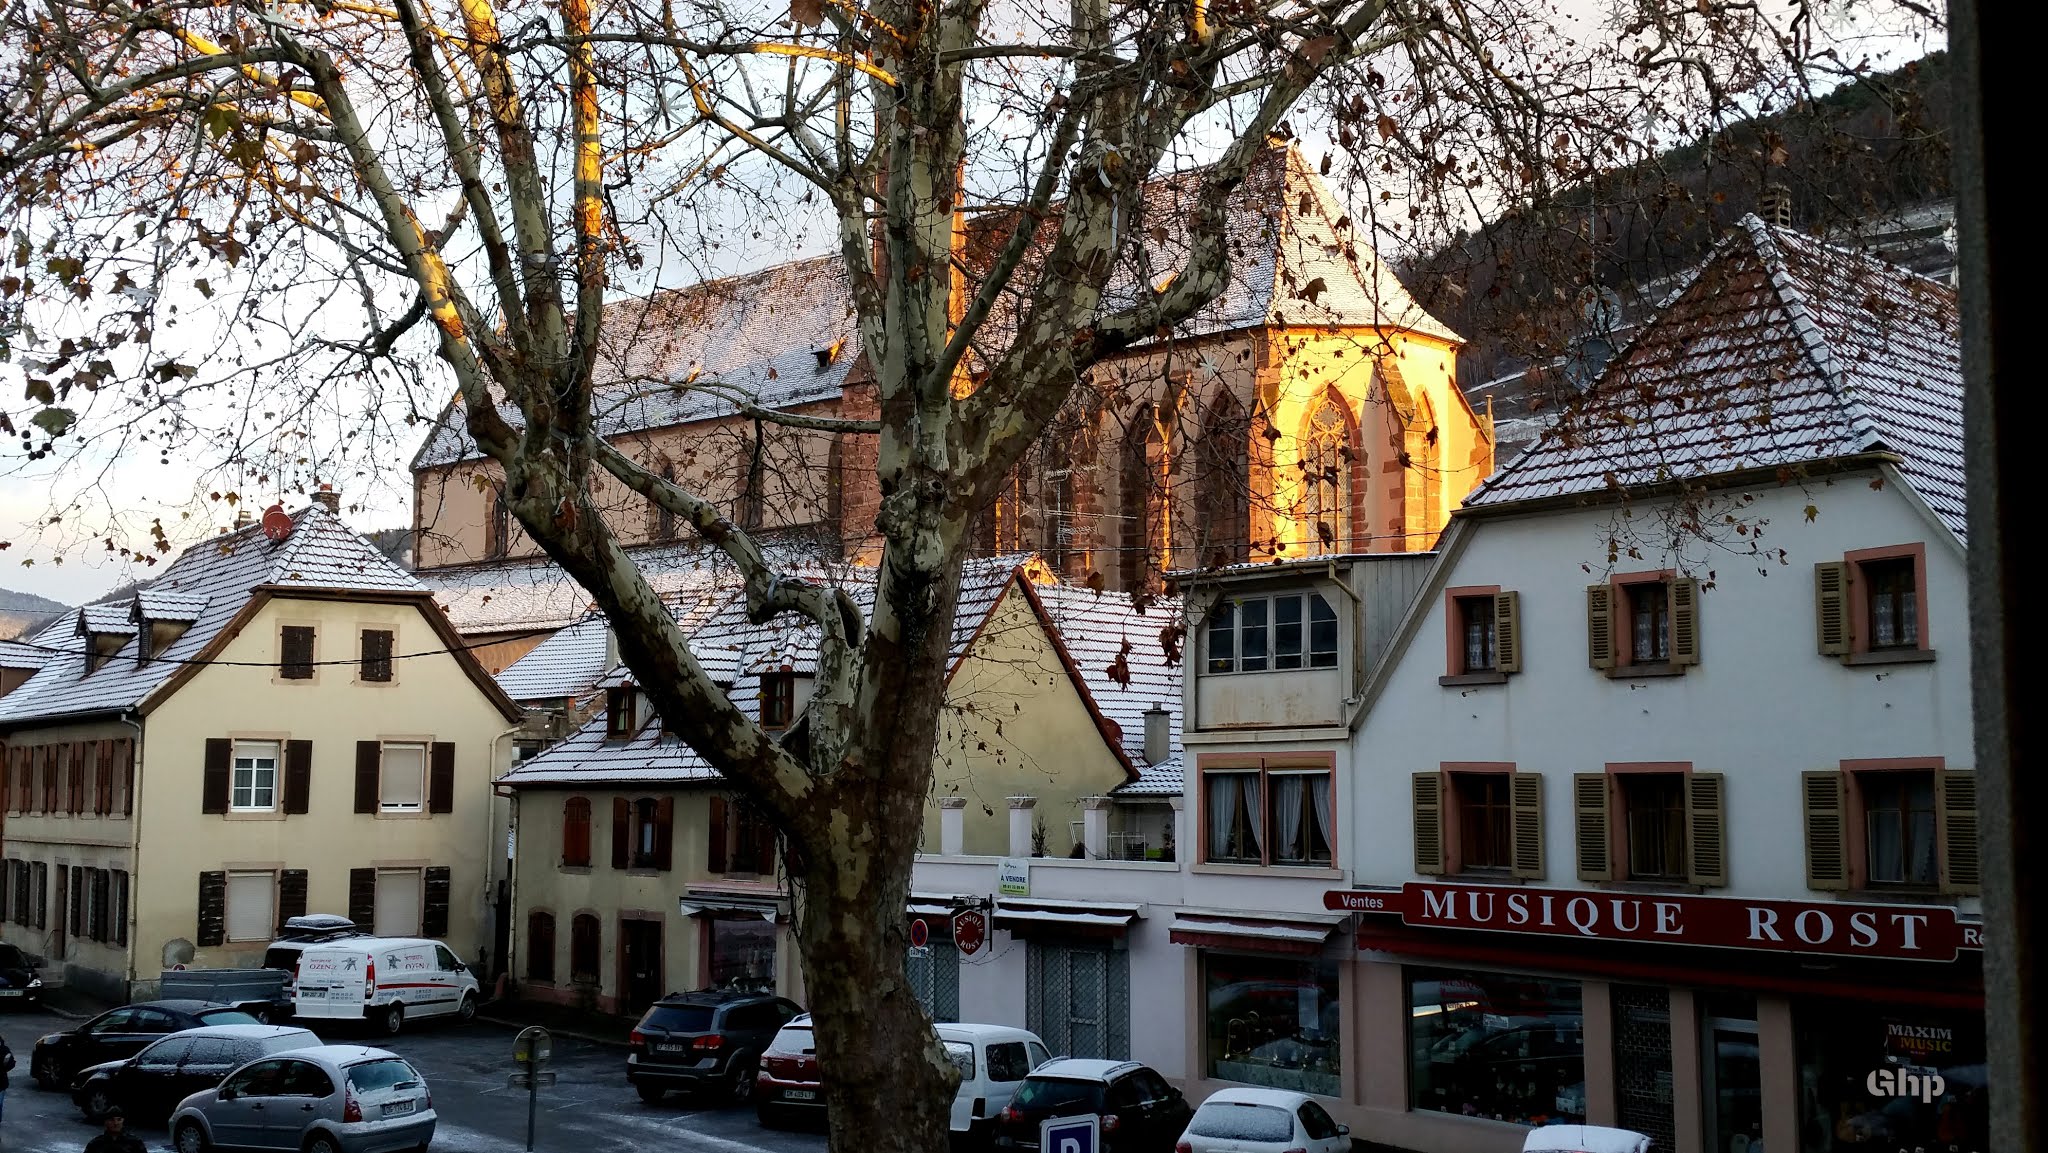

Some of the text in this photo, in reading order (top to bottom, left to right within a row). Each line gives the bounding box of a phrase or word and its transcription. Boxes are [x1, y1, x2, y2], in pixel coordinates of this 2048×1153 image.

[1006, 876, 1027, 884] VENDRE
[1341, 894, 1384, 909] Ventes
[956, 915, 985, 935] MUSIQUE
[1421, 889, 1928, 950] MUSIQUE ROST
[960, 938, 980, 950] ROST
[1887, 1023, 1953, 1041] MAXIM
[1901, 1037, 1953, 1053] MUSIC
